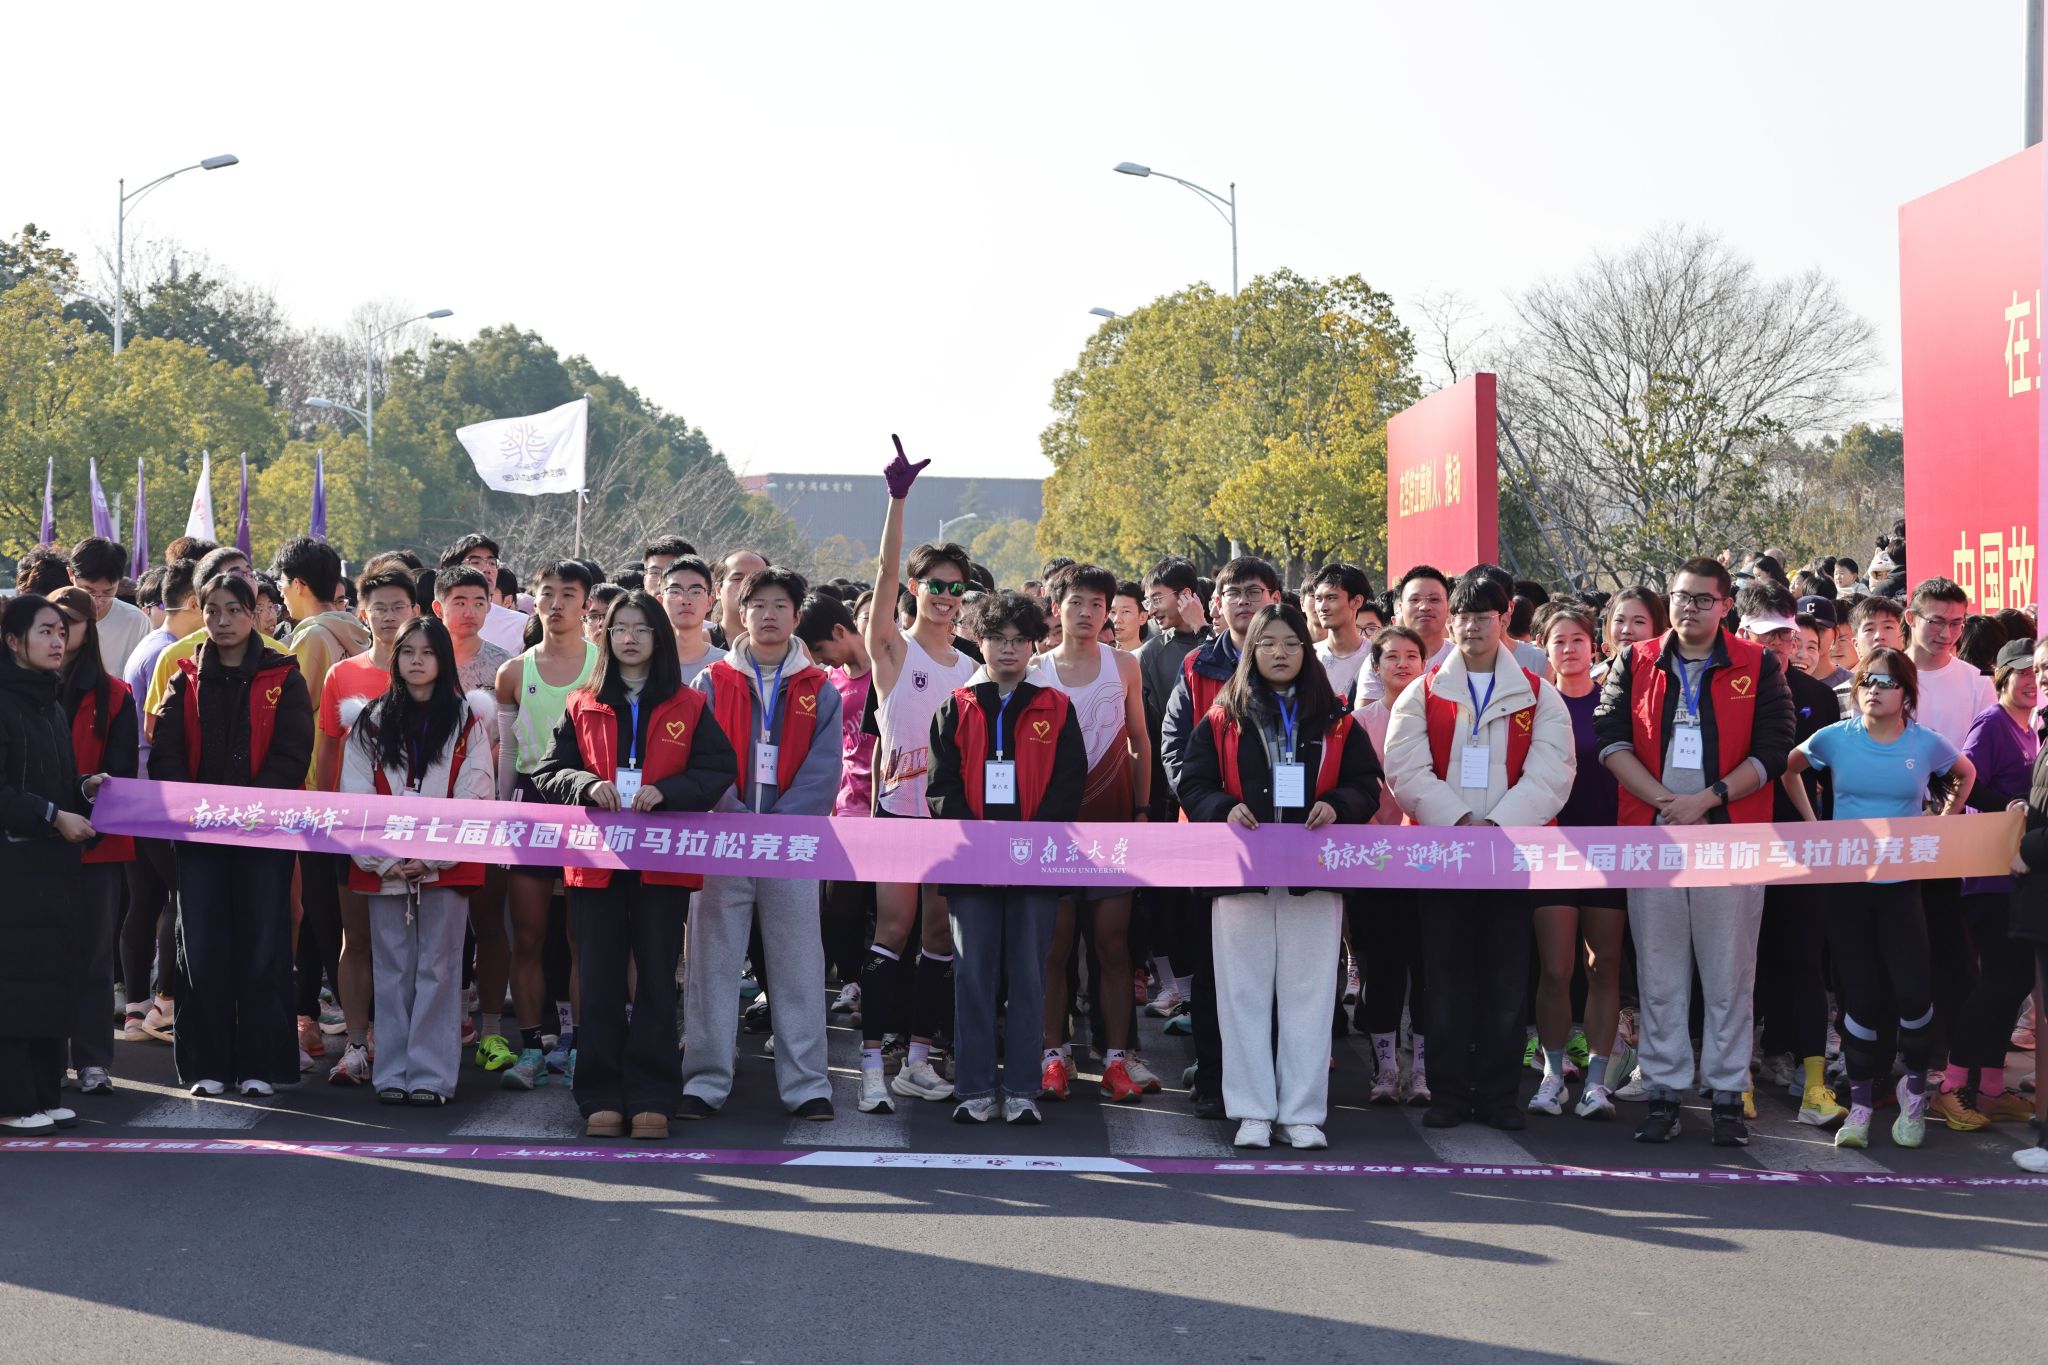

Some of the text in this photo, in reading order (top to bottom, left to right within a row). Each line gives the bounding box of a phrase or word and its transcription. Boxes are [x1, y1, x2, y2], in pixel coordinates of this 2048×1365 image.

[2004, 289, 2041, 398] 在
[383, 815, 821, 863] 第七届校园迷你马拉松竞赛
[1512, 836, 1941, 872] 第七届校园迷你马拉松竞赛
[1040, 866, 1128, 875] NANJING UNIVERSITY
